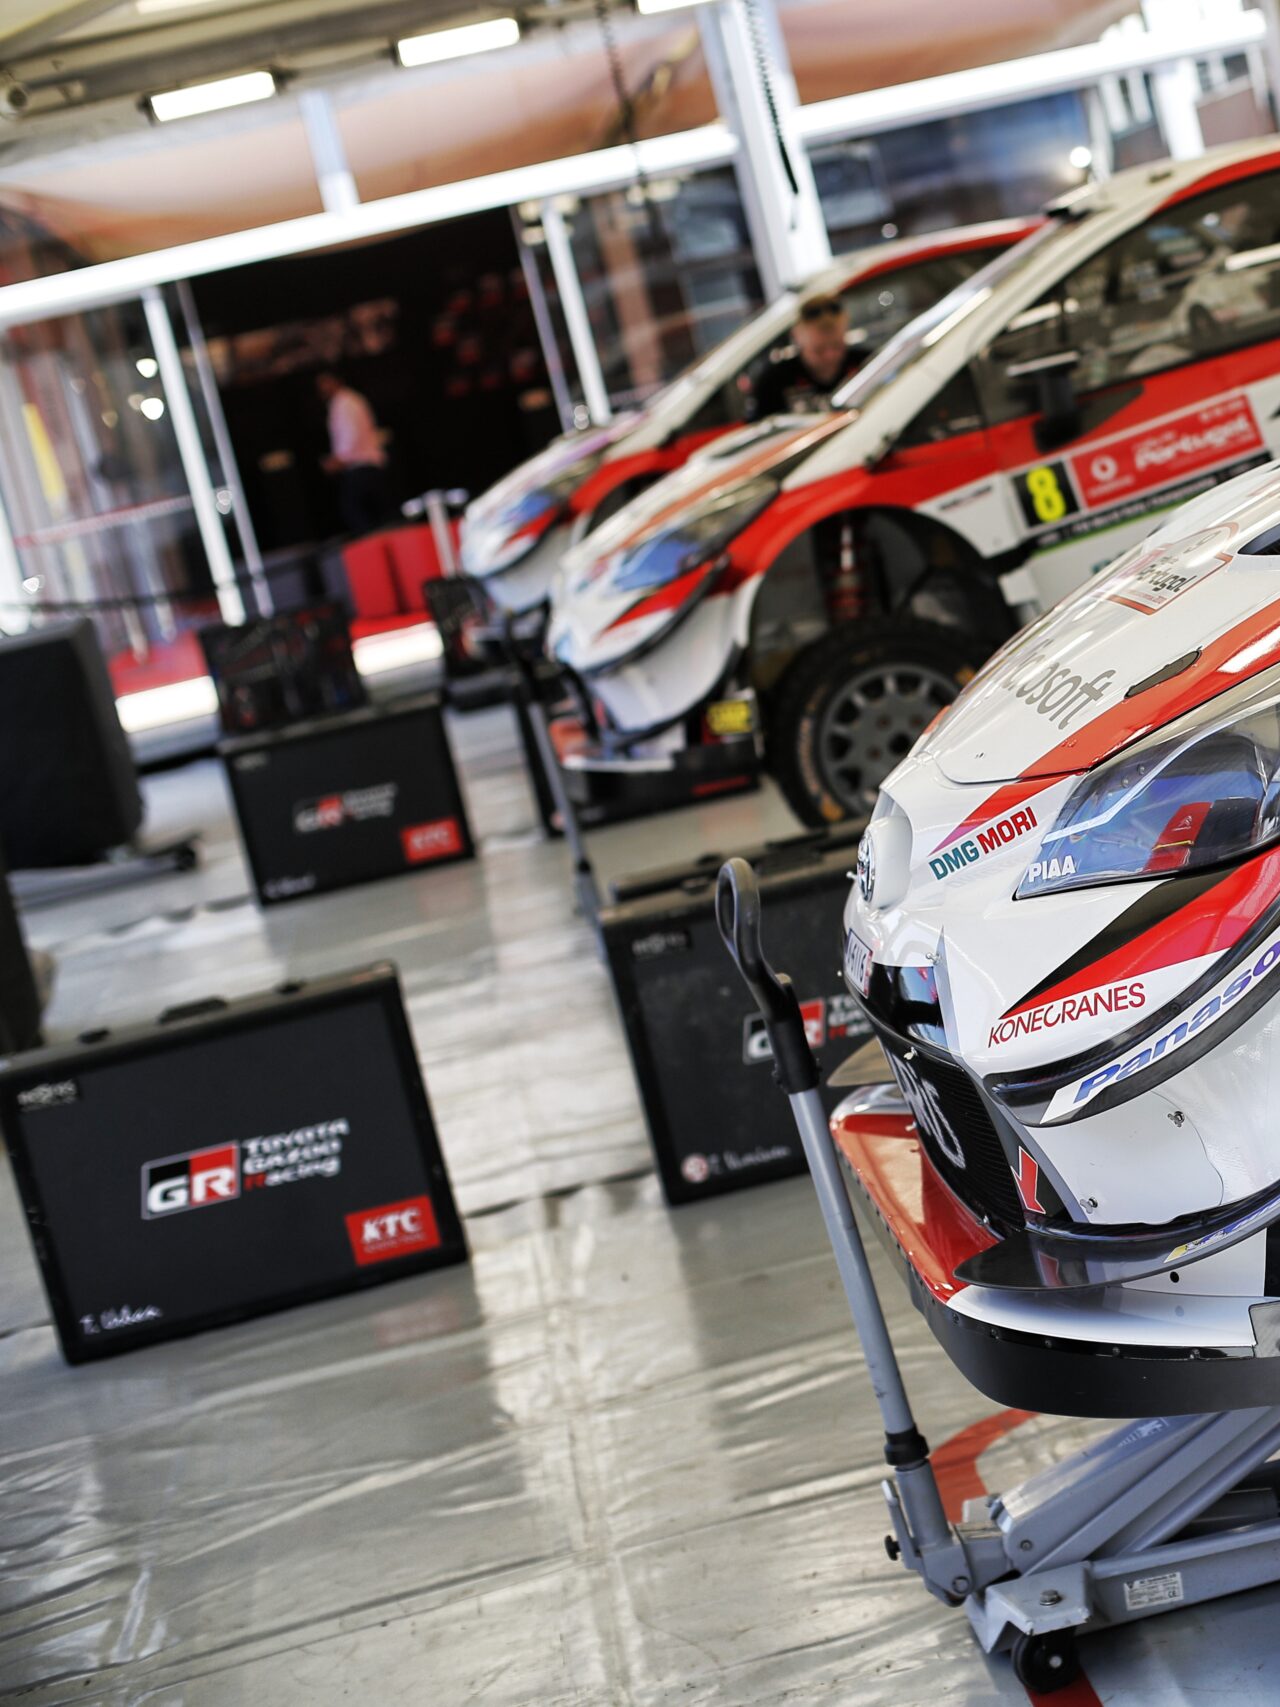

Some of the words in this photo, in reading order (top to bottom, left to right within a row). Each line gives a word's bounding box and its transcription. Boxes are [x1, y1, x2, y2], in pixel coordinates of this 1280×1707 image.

[1026, 465, 1067, 524] 8
[928, 840, 980, 881] DMG
[976, 806, 1038, 854] MORI
[1027, 854, 1077, 883] PIAA
[987, 981, 1147, 1048] KONECRANES
[147, 1164, 238, 1214] GR
[362, 1206, 423, 1244] KTC
